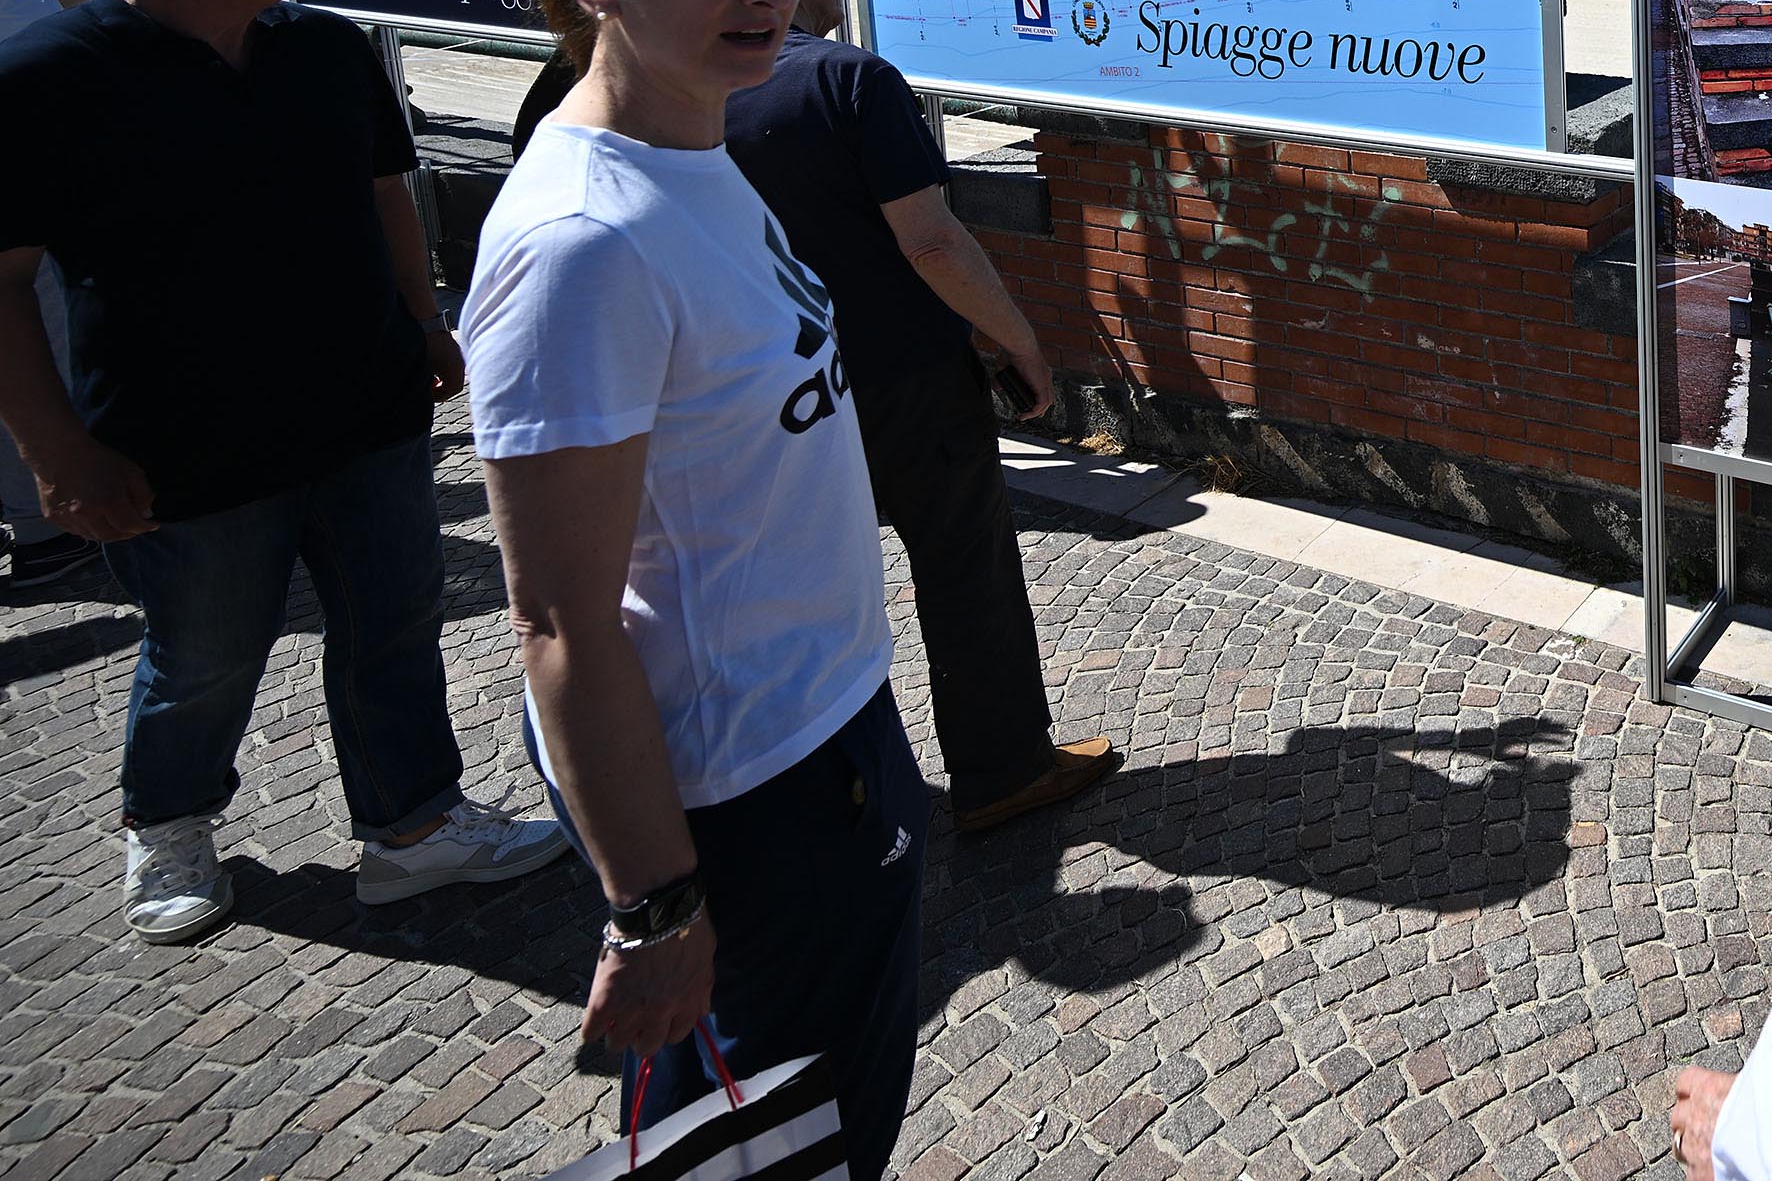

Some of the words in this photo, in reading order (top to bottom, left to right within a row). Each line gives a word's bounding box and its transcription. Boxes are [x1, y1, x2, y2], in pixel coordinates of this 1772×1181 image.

[1136, 0, 1313, 80] Spiagge
[1328, 33, 1486, 84] nuove
[1100, 66, 1133, 77] AMBITO
[1134, 66, 1140, 77] 2
